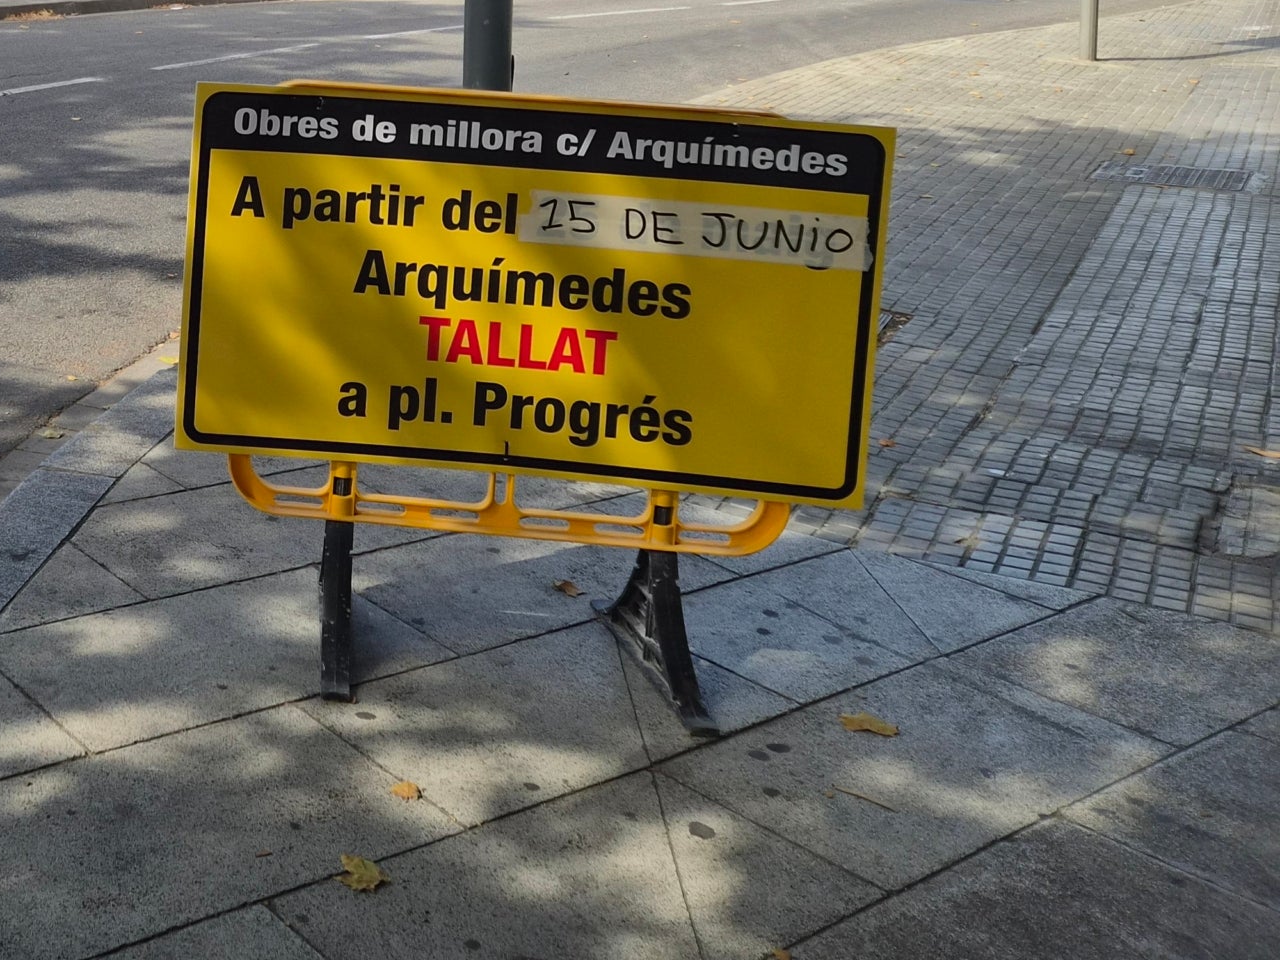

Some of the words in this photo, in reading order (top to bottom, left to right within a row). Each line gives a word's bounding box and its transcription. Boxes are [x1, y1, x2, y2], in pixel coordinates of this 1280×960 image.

[233, 106, 339, 142] Obres
[351, 114, 398, 145] de
[410, 120, 544, 155] millora
[555, 127, 598, 157] c/
[606, 130, 849, 178] Arquímedes
[230, 175, 266, 218] A
[282, 180, 424, 230] partir
[441, 190, 519, 236] del
[540, 198, 597, 234] 15
[624, 208, 684, 245] DE
[353, 249, 692, 321] Arquímedes
[418, 315, 618, 376] TALLAT
[337, 382, 368, 418] a
[387, 377, 453, 430] pl.
[472, 380, 693, 448] Progrés
